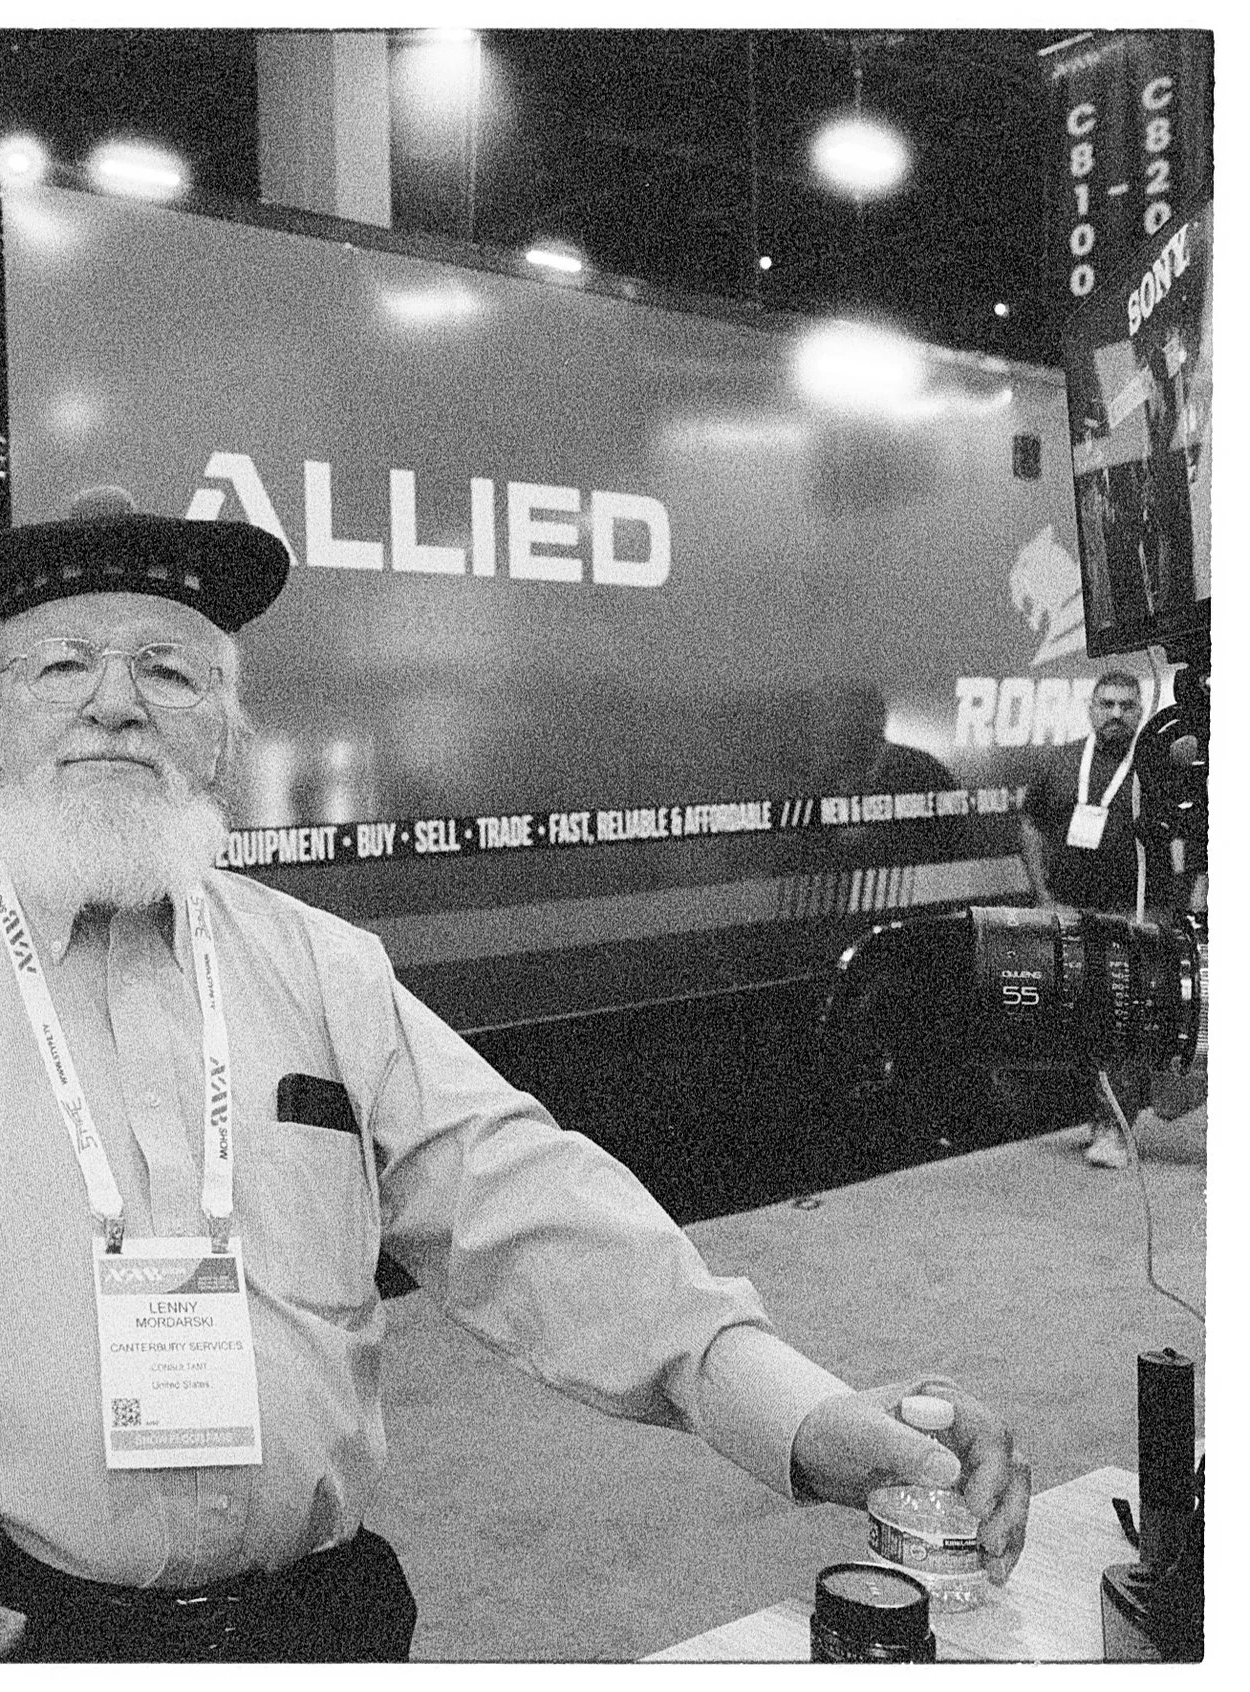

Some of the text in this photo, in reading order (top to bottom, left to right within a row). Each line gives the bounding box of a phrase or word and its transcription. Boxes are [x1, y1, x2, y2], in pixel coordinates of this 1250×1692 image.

[1066, 102, 1097, 297] C8100
[1128, 223, 1191, 337] SONY
[184, 450, 672, 588] ALLIED
[356, 823, 397, 858] BUY
[414, 819, 461, 854] SELL
[476, 814, 534, 849] TRADE
[549, 811, 596, 846] FAST,
[596, 807, 669, 842] RELIABLE
[684, 801, 772, 837] AFFORDABLE
[1002, 985, 1040, 1006] 55
[218, 1126, 229, 1161] SHOW
[135, 1316, 214, 1328] MORDARSKI
[149, 1301, 198, 1315] LENNY
[110, 1340, 243, 1353] CANTERBURY SERVICES
[151, 1380, 210, 1390] United States
